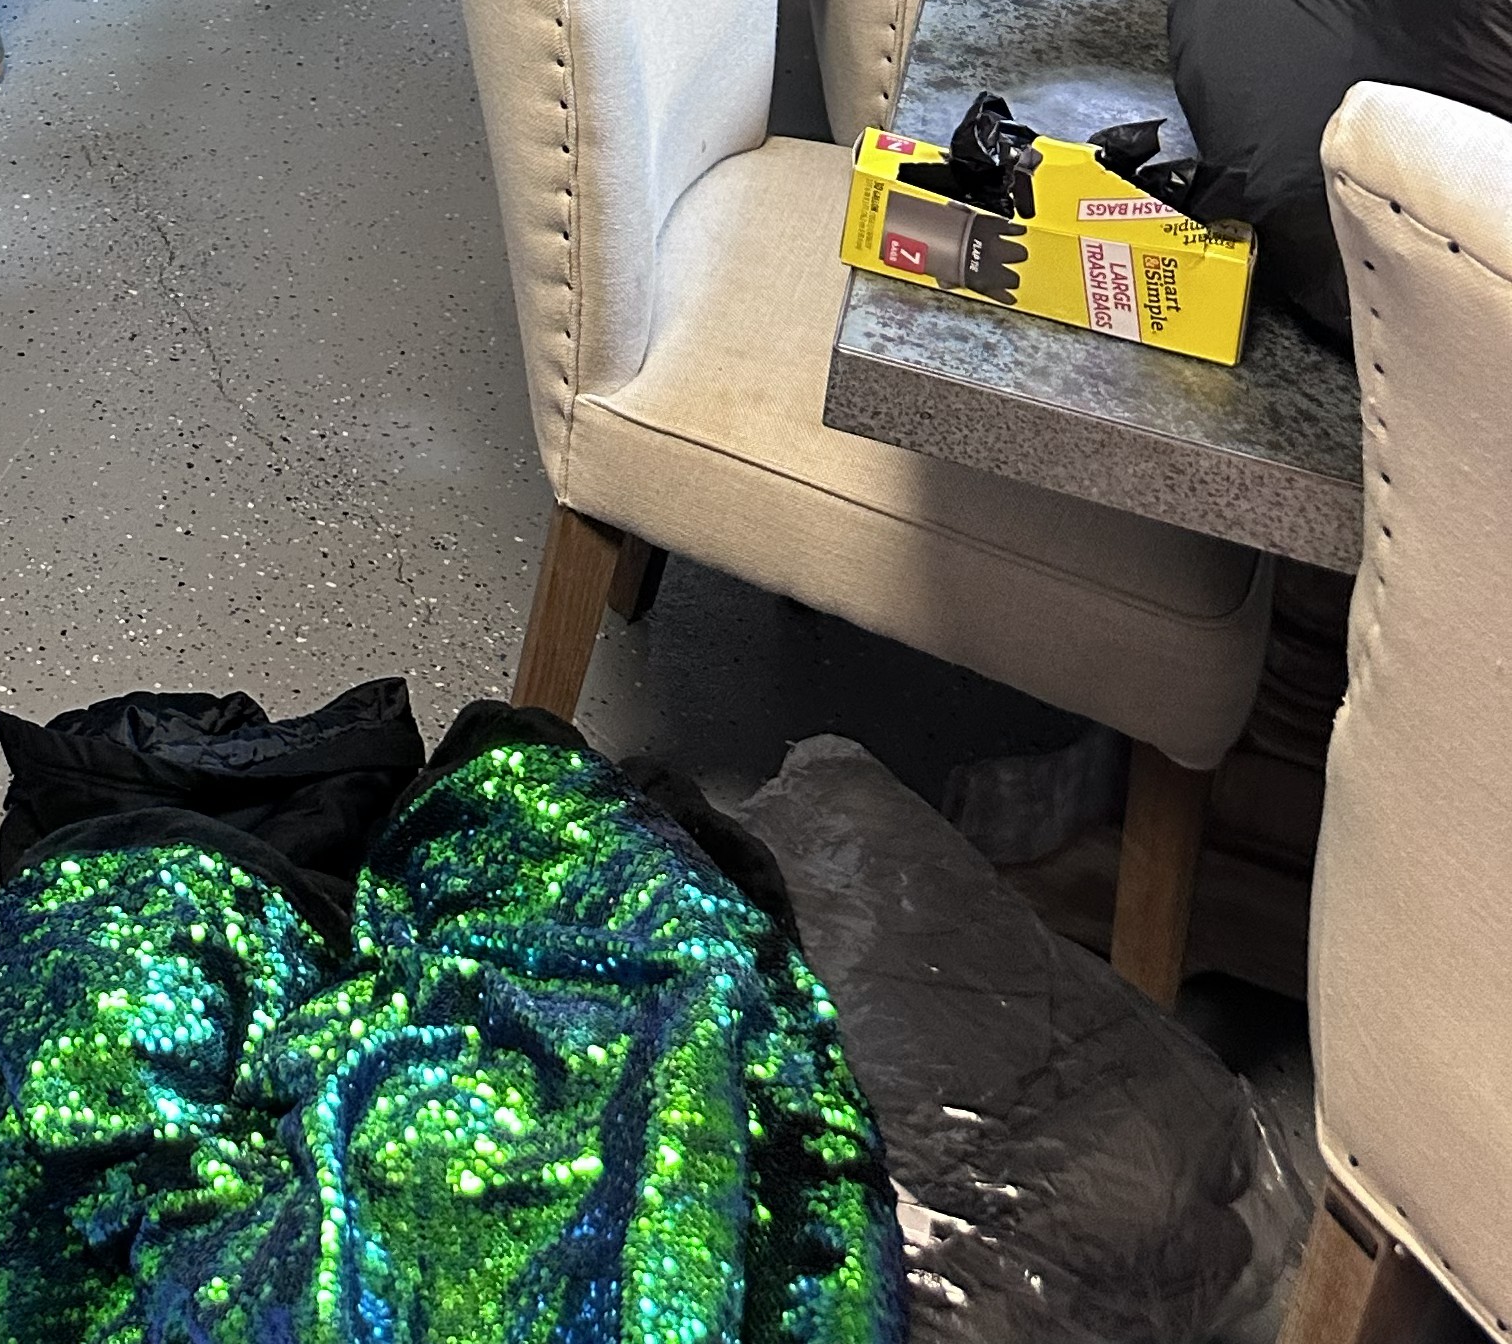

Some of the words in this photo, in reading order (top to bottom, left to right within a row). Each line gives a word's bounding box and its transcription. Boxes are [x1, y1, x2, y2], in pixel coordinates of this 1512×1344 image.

[1087, 203, 1129, 216] BAGS
[900, 248, 921, 265] 7
[1085, 242, 1108, 292] TRASH
[1109, 262, 1132, 312] LARGE
[1161, 256, 1181, 312] Smart
[1091, 292, 1113, 330] BAGS
